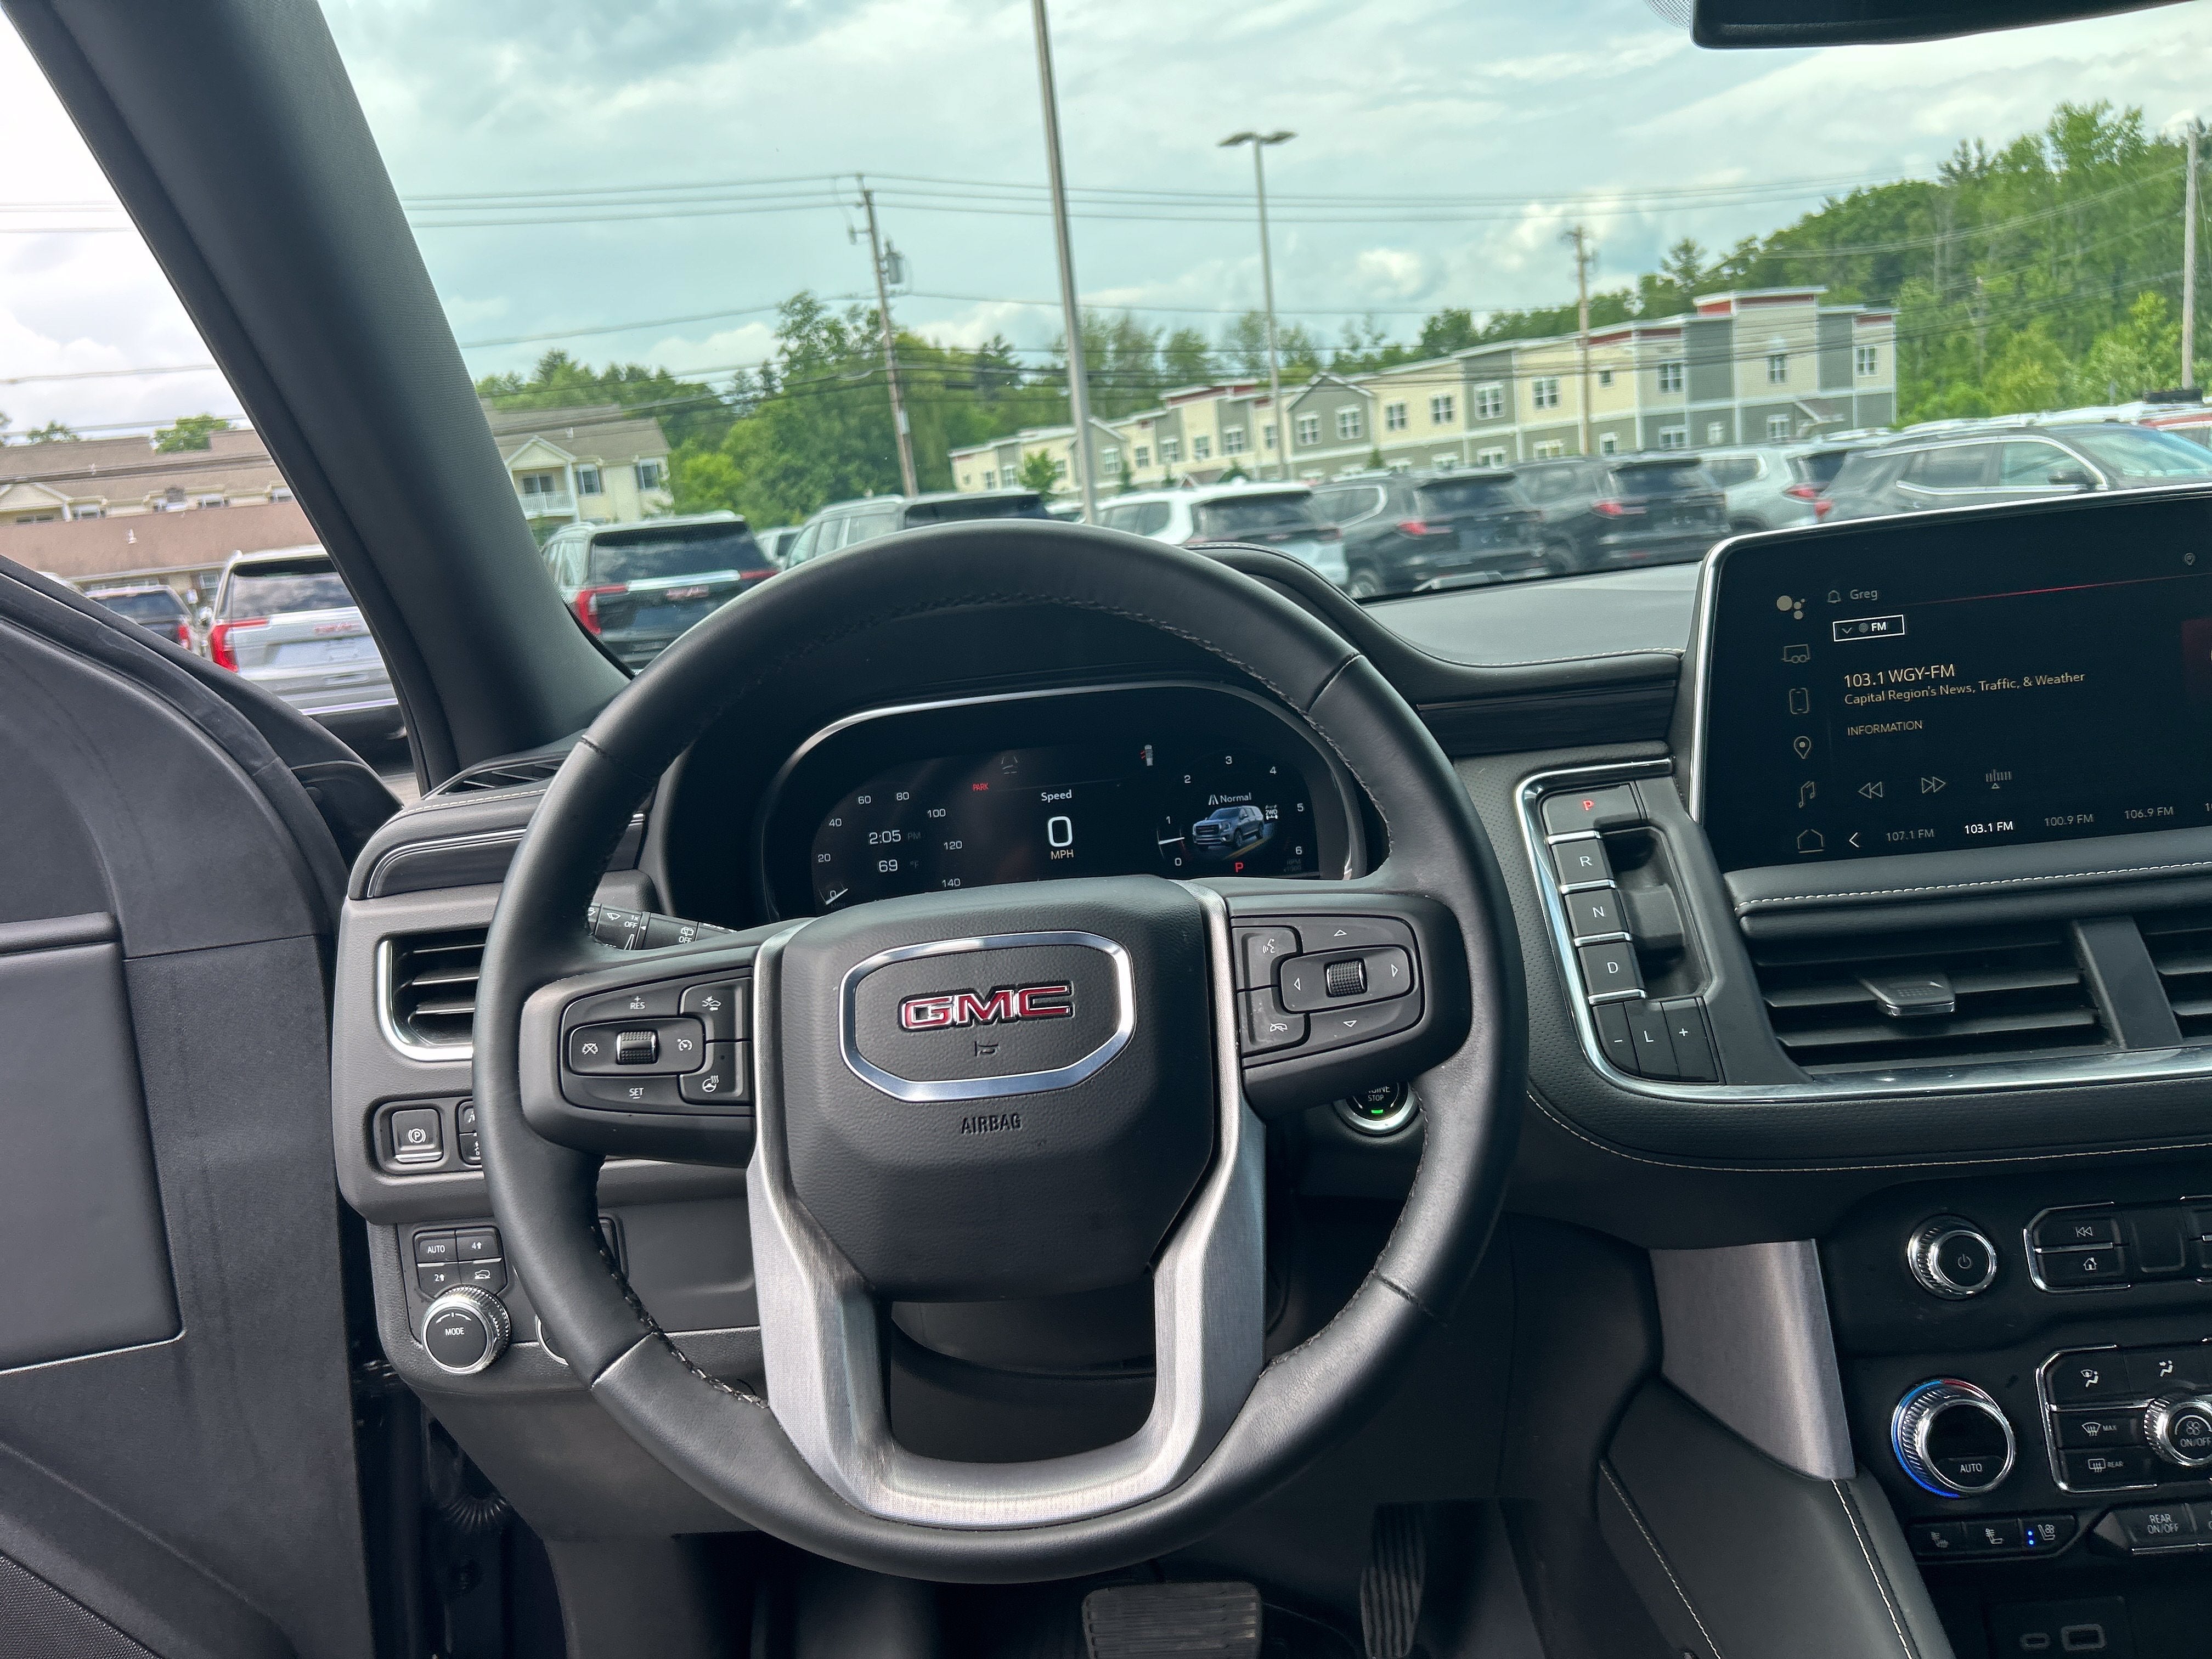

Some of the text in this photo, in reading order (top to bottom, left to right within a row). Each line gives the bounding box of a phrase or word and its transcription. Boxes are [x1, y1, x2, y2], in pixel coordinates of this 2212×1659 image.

[1850, 589, 1878, 601] Greg
[1871, 622, 1886, 631] FM
[1844, 664, 1955, 687] 103.1 WGY-FM
[1844, 672, 2085, 706] Capital Region's News, Traffic, & Weather
[1847, 720, 1923, 736] INFORMATION
[1225, 756, 1232, 764] 3
[1269, 766, 1277, 775] 4
[1184, 775, 1191, 783] 2
[972, 782, 989, 791] PARK
[858, 795, 871, 804] 60
[896, 792, 910, 801] 80
[1041, 789, 1072, 803] Speed
[1220, 792, 1251, 803] Normal
[1297, 803, 1304, 812] 5
[1582, 799, 1594, 811] P
[927, 808, 946, 818] 100
[2124, 806, 2174, 819] 106.9 FM
[829, 818, 842, 827] 40
[1166, 816, 1171, 825] 1
[2044, 814, 2094, 827] 100.9 FM
[1048, 816, 1073, 847] 0
[1965, 821, 2013, 834] 103.1 FM
[869, 830, 922, 845] 2:05 PM
[1886, 828, 1935, 842] 107.1 FM
[944, 840, 962, 850] 120
[1295, 846, 1302, 855] 6
[817, 854, 831, 862] 20
[1051, 849, 1074, 860] MPH
[878, 859, 898, 873] 69
[1175, 857, 1182, 866] 0
[1579, 856, 1593, 867] R
[1235, 862, 1244, 873] P
[942, 878, 961, 888] 140
[1592, 906, 1604, 918] N
[1607, 961, 1618, 974] D
[630, 1001, 645, 1010] RES
[901, 984, 1073, 1030] GMC
[1644, 1031, 1654, 1043] L
[629, 1087, 644, 1096] SET
[961, 1113, 1022, 1135] AIRBAG
[427, 1244, 445, 1254] AUTO
[445, 1327, 465, 1336] MODE
[1960, 1463, 1983, 1473] AUTO
[2149, 1513, 2172, 1524] REAR
[2147, 1523, 2179, 1534] ON/OFF
